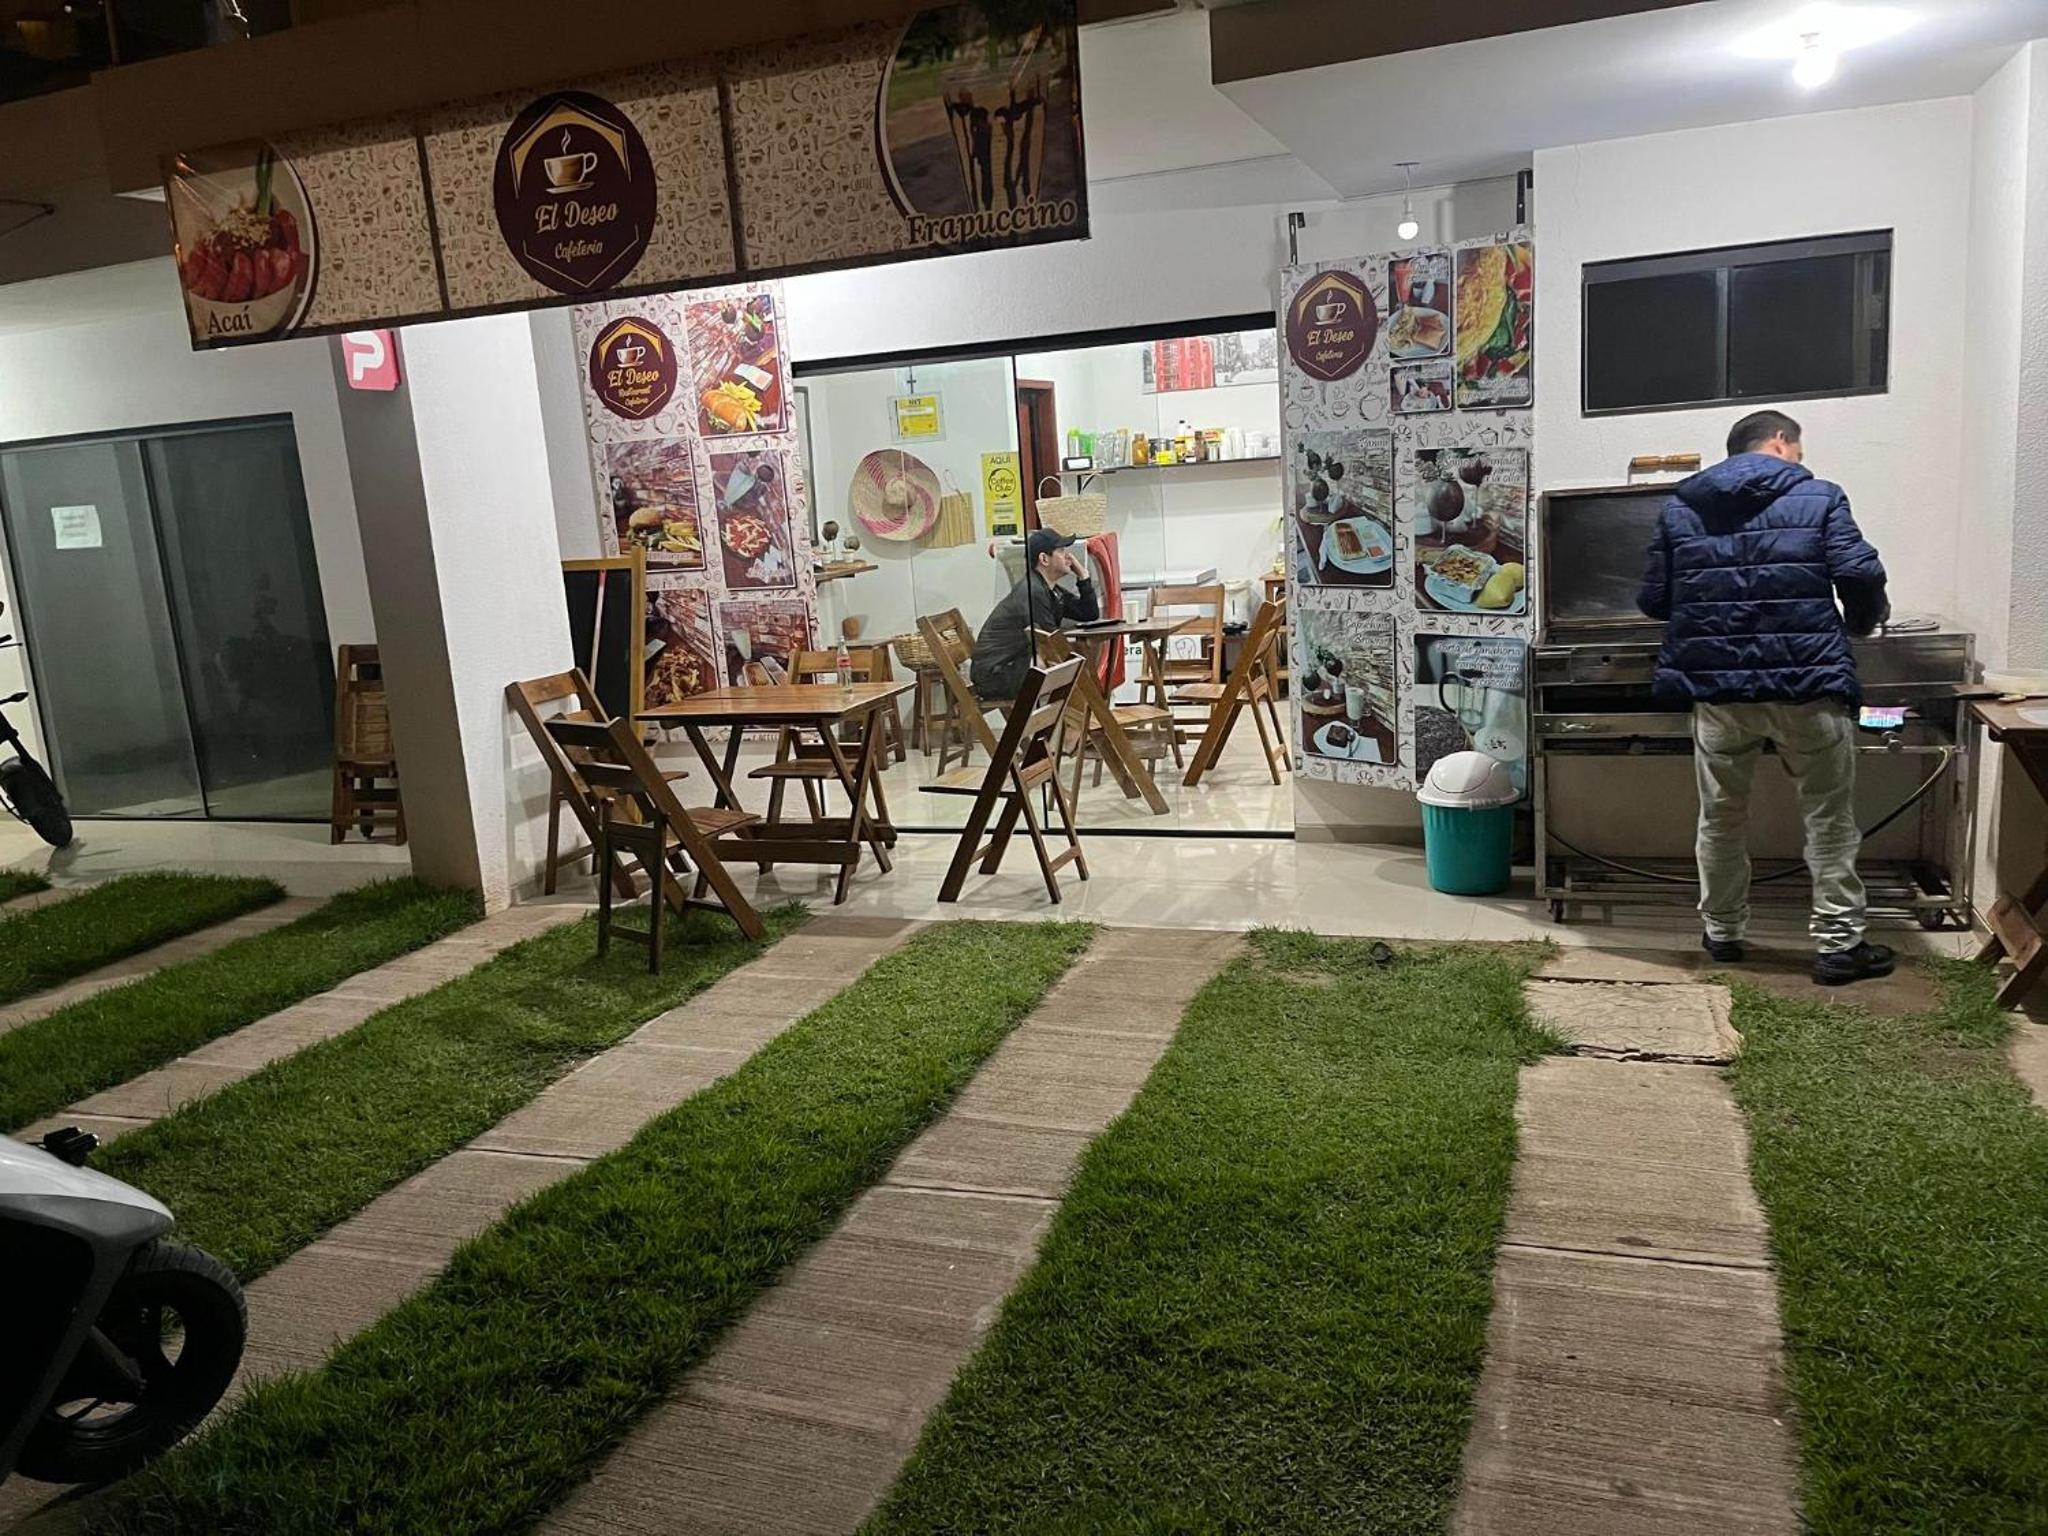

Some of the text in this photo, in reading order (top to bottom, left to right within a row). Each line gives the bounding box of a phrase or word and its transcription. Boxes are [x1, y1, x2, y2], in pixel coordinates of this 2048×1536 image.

[535, 201, 618, 234] El Deseo
[907, 195, 1077, 245] Frapuccino
[207, 305, 253, 334] Acaí
[1306, 328, 1355, 346] El Deseo
[607, 368, 660, 387] El Deseo
